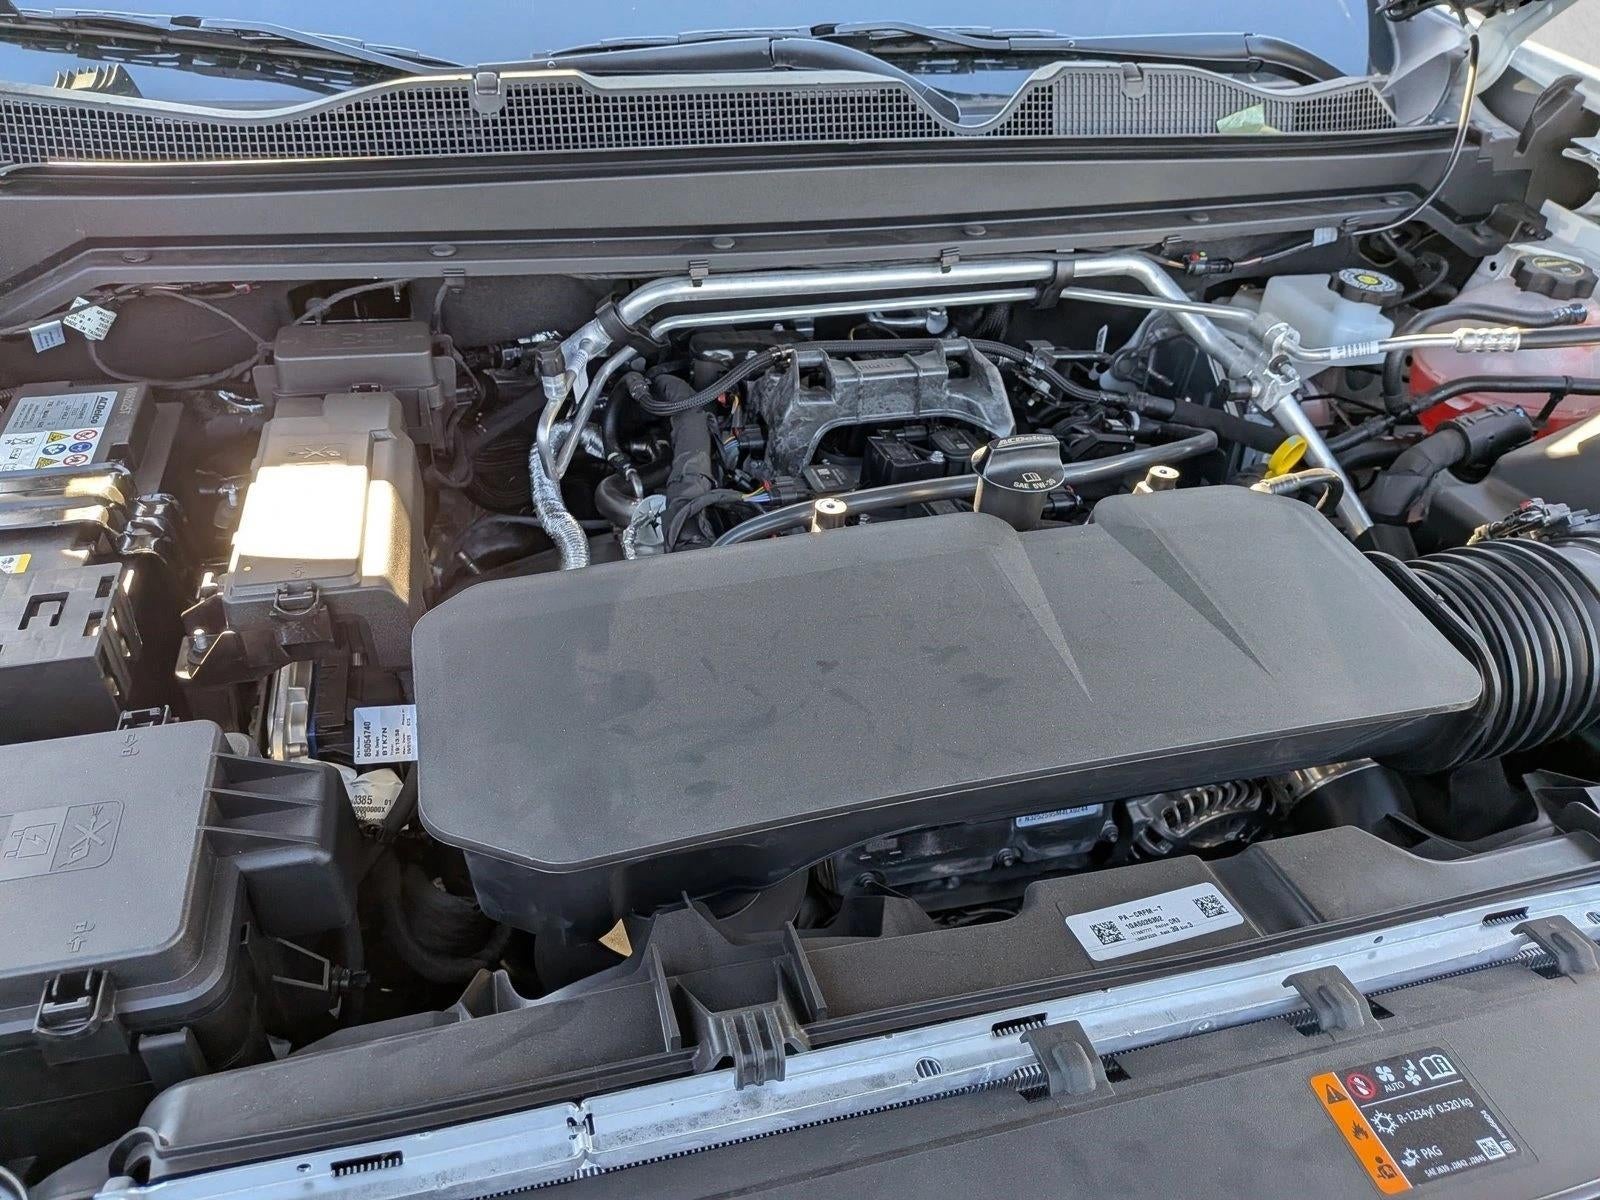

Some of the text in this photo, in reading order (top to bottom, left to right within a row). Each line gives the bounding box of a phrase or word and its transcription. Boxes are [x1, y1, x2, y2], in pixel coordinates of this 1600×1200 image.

[90, 395, 109, 424] ACDelco
[1013, 481, 1030, 489] SAE
[363, 721, 372, 758] 85054740
[1384, 1080, 1405, 1093] AUTO
[1396, 1097, 1474, 1124] R-1234yf 0.520 kg
[1420, 1145, 1443, 1159] PAG
